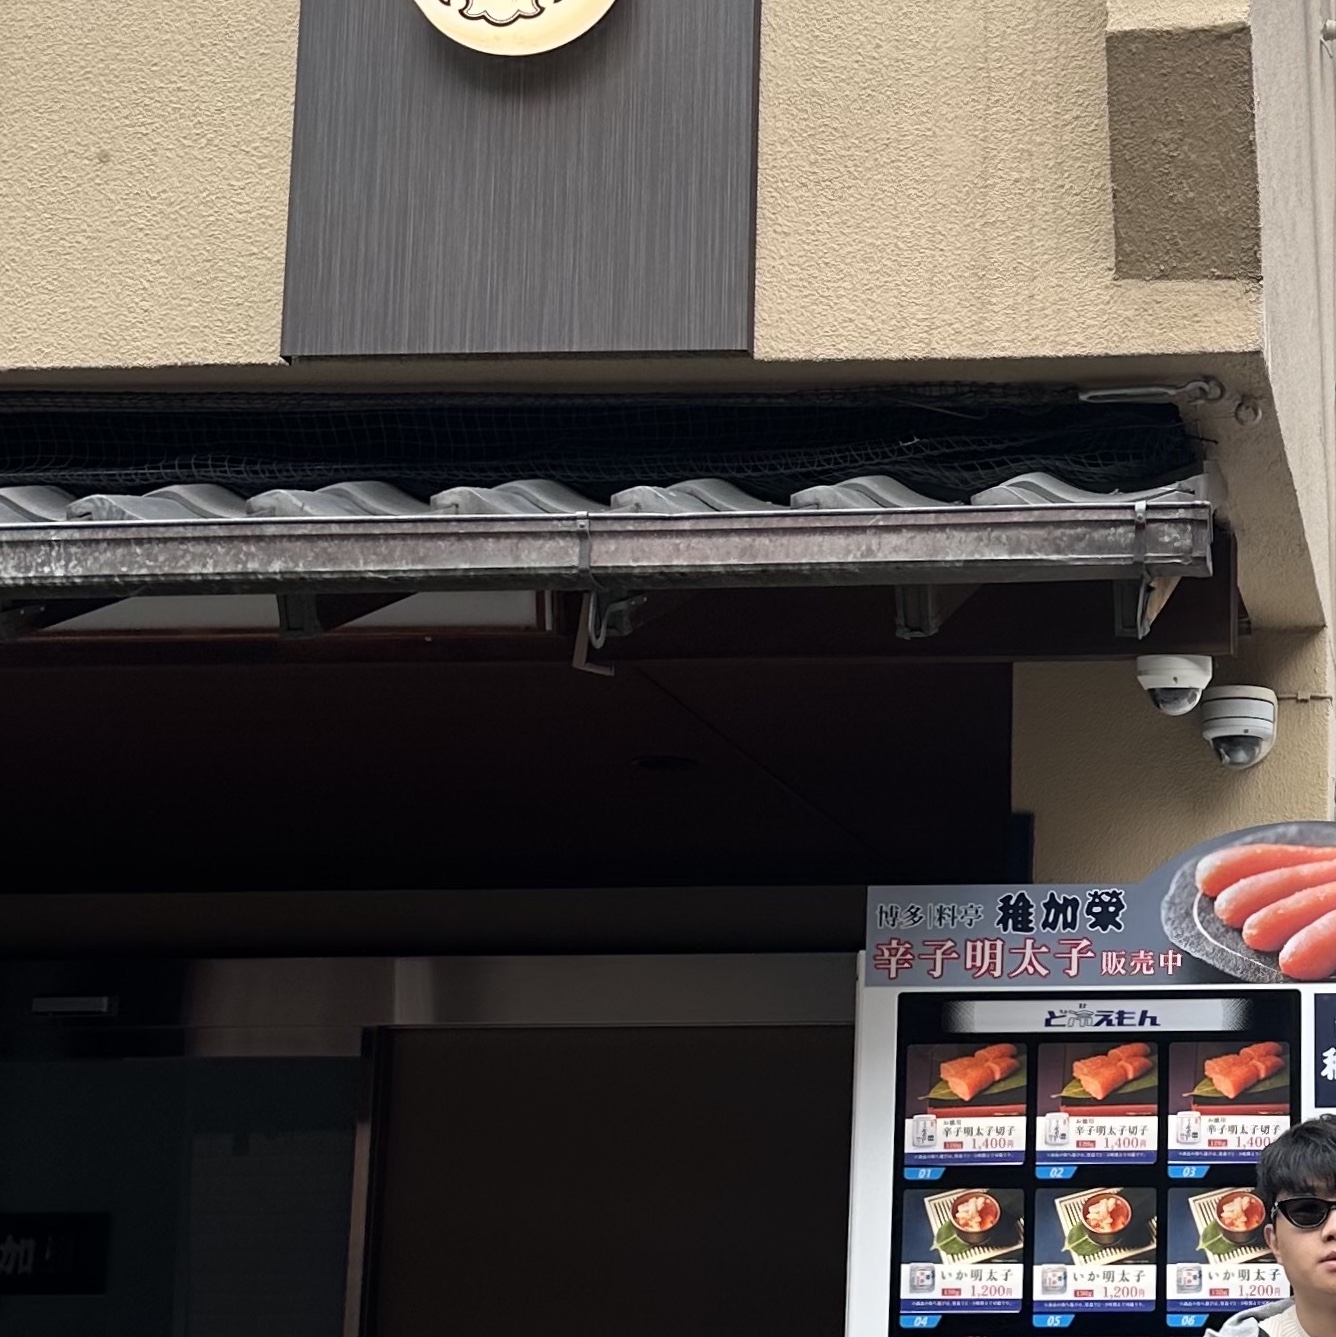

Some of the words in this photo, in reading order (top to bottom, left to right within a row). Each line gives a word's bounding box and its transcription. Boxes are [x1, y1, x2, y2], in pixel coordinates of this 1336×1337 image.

[872, 937, 1097, 980] 辛子明太子
[1100, 949, 1183, 977] 販売中
[1235, 1136, 1274, 1149] 1,400
[918, 1169, 932, 1179] 01
[1049, 1168, 1065, 1178] 02
[1182, 1167, 1197, 1177] 03
[941, 1269, 1014, 1282] いか明太子
[1073, 1270, 1146, 1283] いか明太子
[1208, 1268, 1281, 1281] いか明太子
[913, 1316, 928, 1326] 04
[1047, 1316, 1061, 1327] 05
[1181, 1316, 1195, 1326] 06
